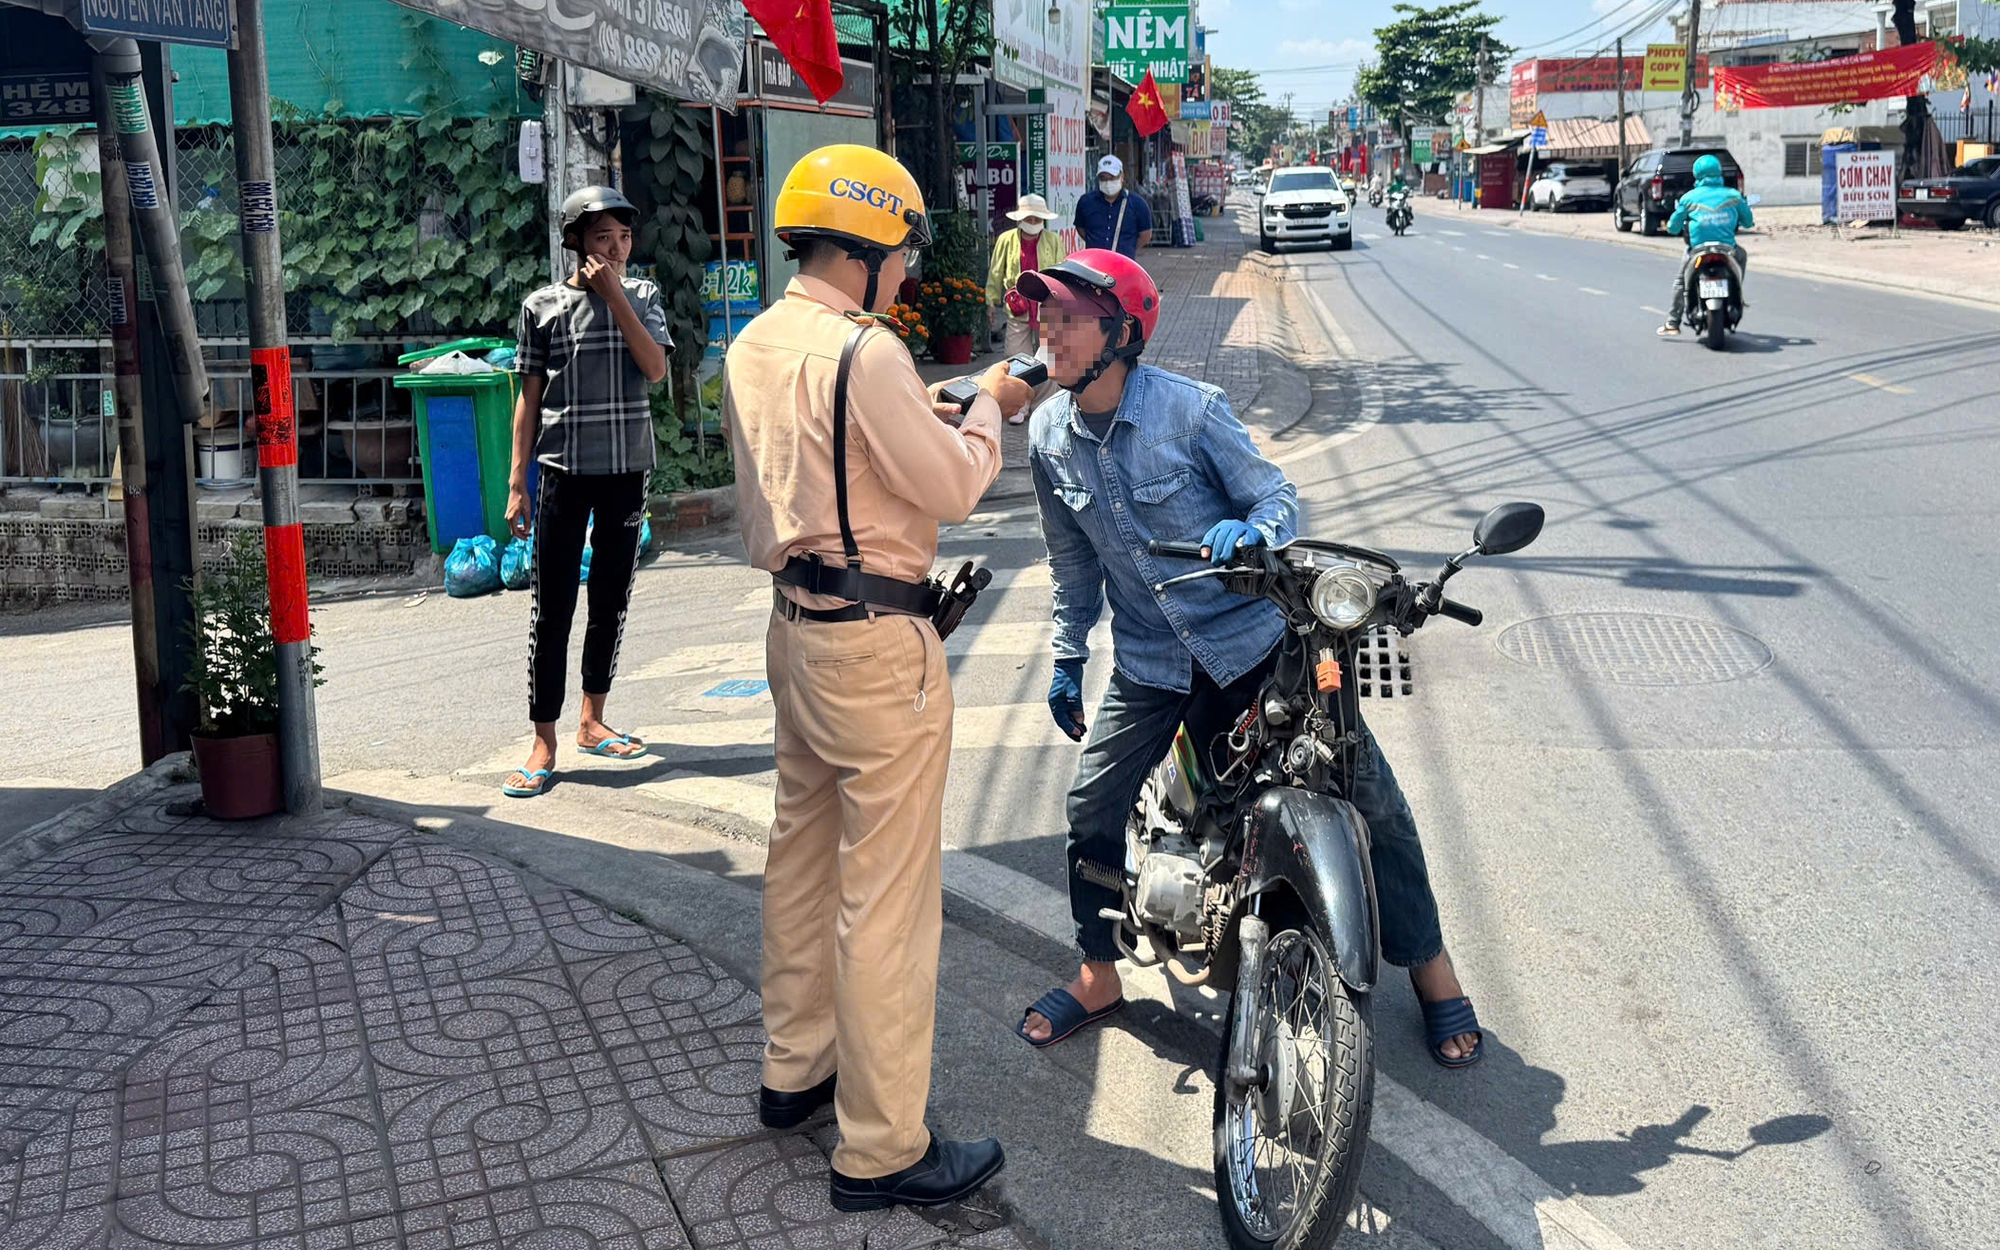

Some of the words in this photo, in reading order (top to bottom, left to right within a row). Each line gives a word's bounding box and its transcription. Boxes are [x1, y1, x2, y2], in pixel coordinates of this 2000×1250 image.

[1107, 8, 1186, 57] NỆM
[1647, 48, 1686, 57] PHOTO
[764, 57, 777, 86] TRÀ
[1650, 62, 1680, 72] COPY
[8, 99, 90, 117] 348
[988, 164, 1014, 185] BÒ
[1839, 165, 1863, 188] CƠM
[1866, 165, 1892, 187] CHAY
[829, 177, 904, 216] CSGT
